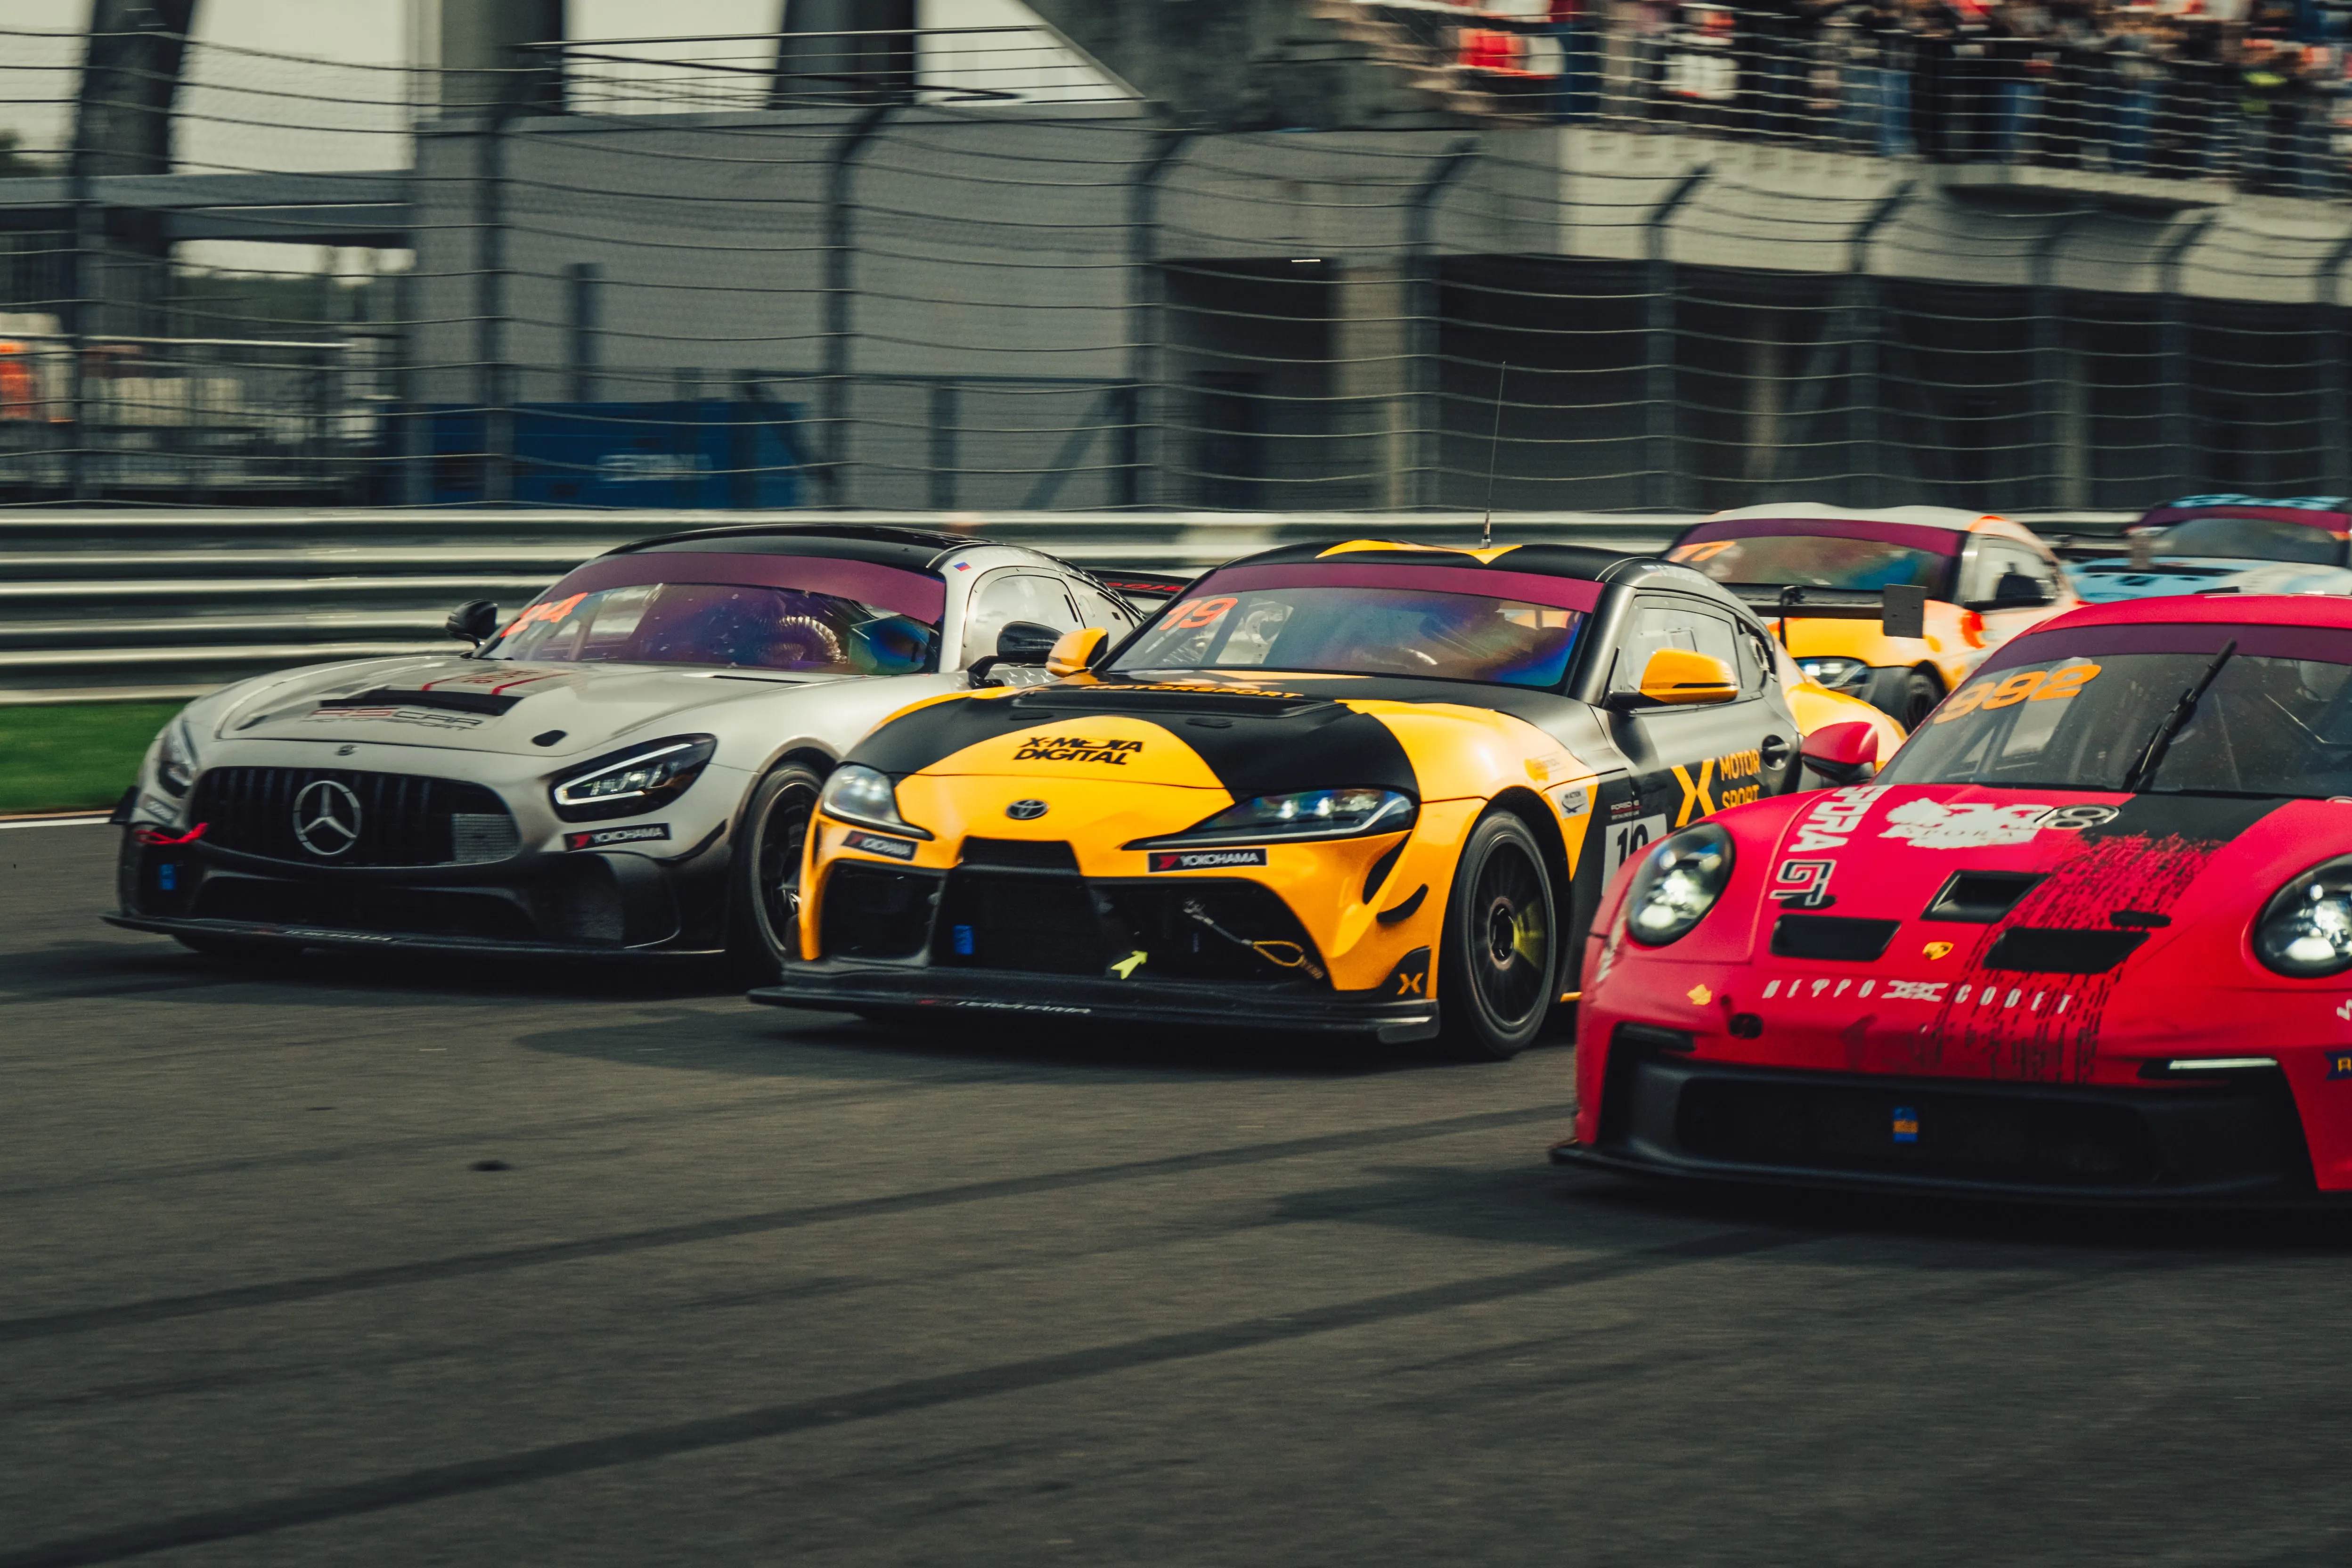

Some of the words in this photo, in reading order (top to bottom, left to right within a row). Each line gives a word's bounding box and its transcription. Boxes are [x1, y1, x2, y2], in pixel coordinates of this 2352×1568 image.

[1159, 598, 1238, 630] 19
[1080, 685, 1305, 697] MOTORSPORT
[1934, 664, 2101, 724] 992
[1013, 748, 1127, 765] DIGITAL
[1719, 749, 1761, 781] MOTOR
[1722, 784, 1760, 808] SPORT
[1180, 852, 1259, 866] YOKOHAMA
[1768, 859, 1837, 906] GT
